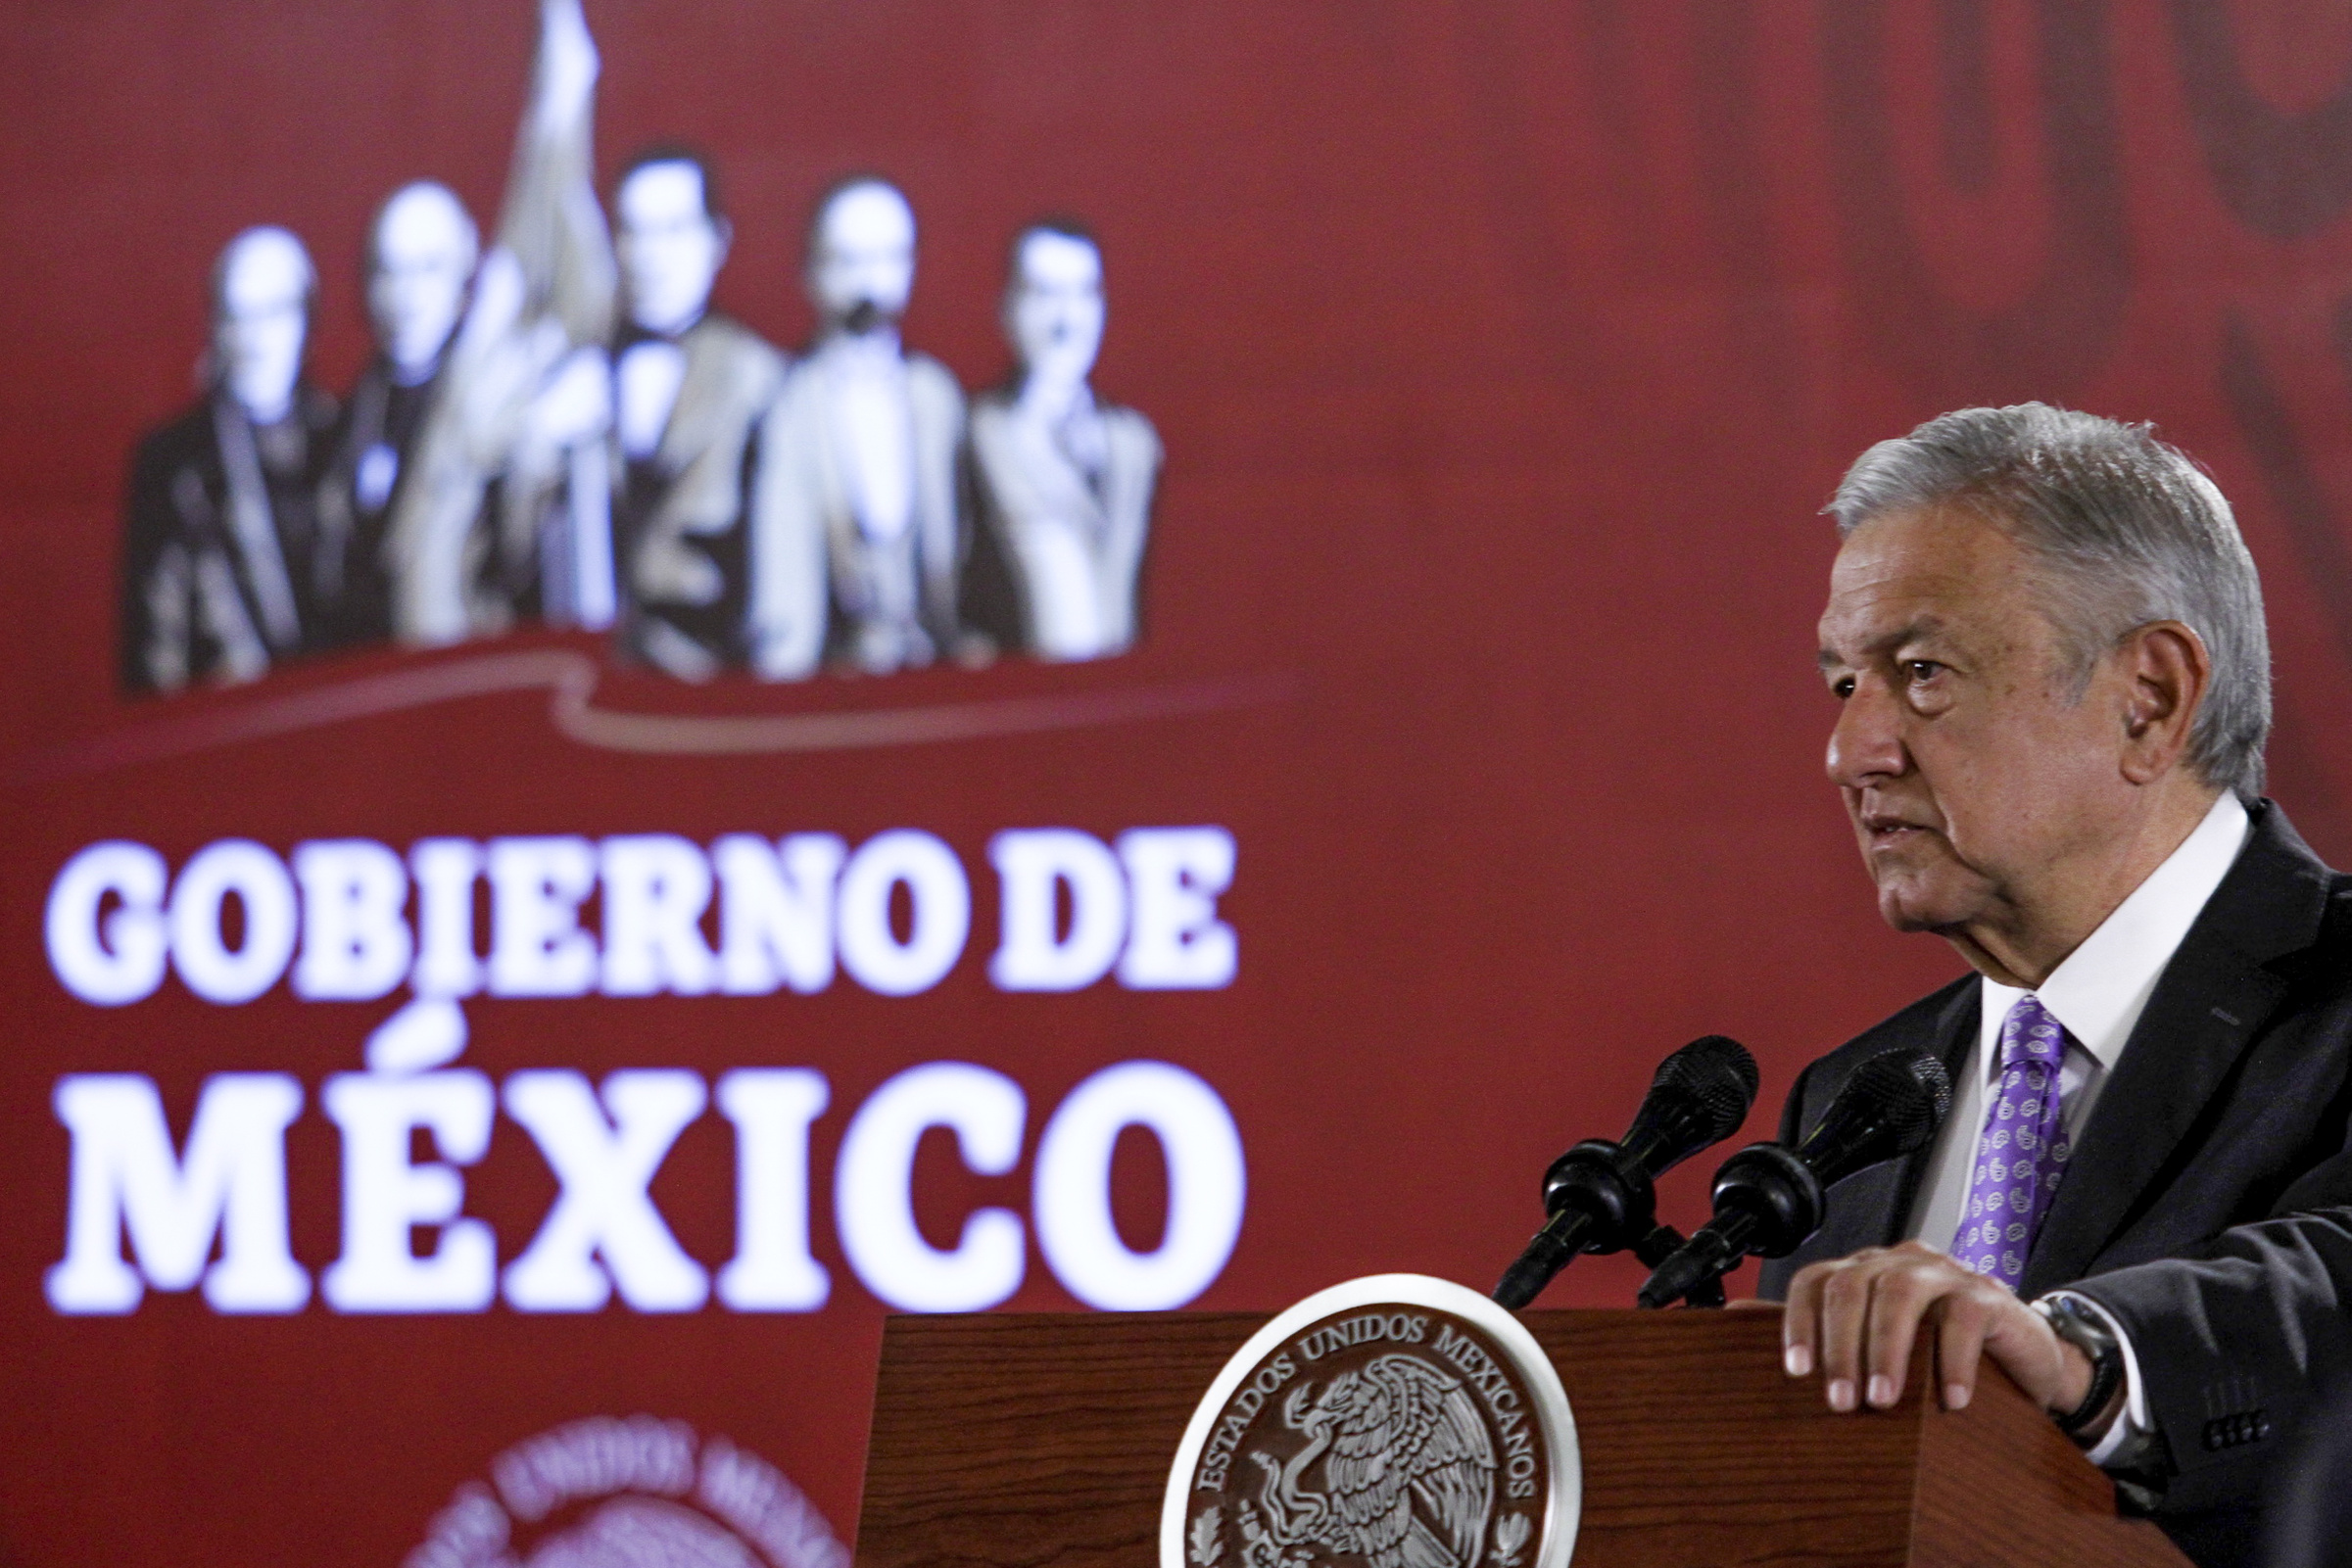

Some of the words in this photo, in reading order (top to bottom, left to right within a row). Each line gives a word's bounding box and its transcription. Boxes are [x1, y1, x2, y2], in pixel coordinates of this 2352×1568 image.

[45, 830, 970, 1005] GOBIERNO
[989, 826, 1237, 990] DE
[45, 997, 1246, 1314] MÉXICO
[1197, 1352, 1297, 1493] ESTADOS
[1297, 1313, 1428, 1361] UNIDOS
[1431, 1324, 1536, 1498] MEXICANOS
